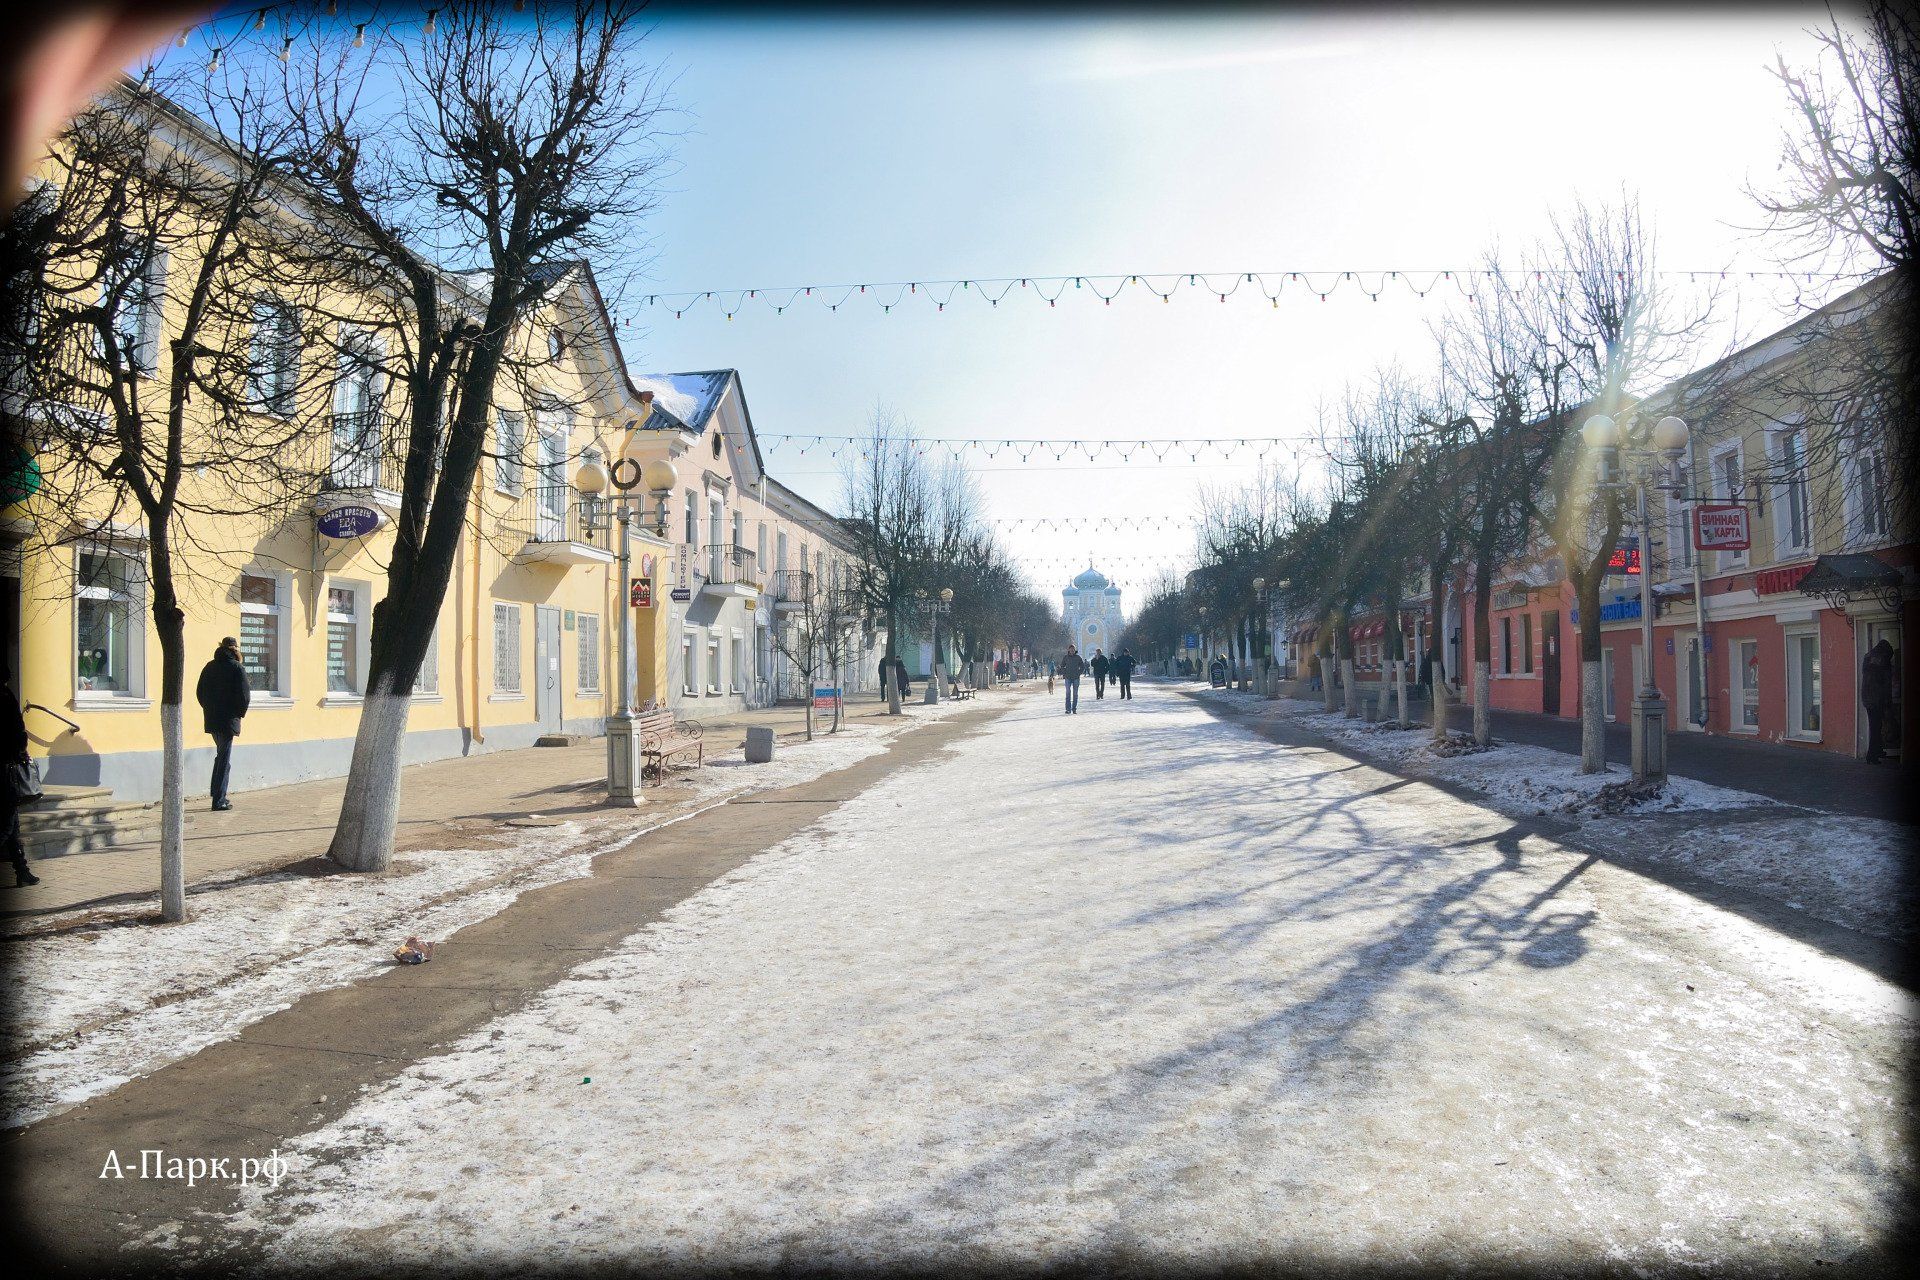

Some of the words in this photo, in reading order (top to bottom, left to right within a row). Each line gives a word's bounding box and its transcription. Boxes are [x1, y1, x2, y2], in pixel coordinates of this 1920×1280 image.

[324, 509, 342, 523] САЛОН
[344, 508, 372, 519] КРАСОТЫ
[1701, 514, 1740, 526] ВИННАЯ
[1714, 527, 1742, 538] КАРТА
[1757, 564, 1816, 595] ВИНН
